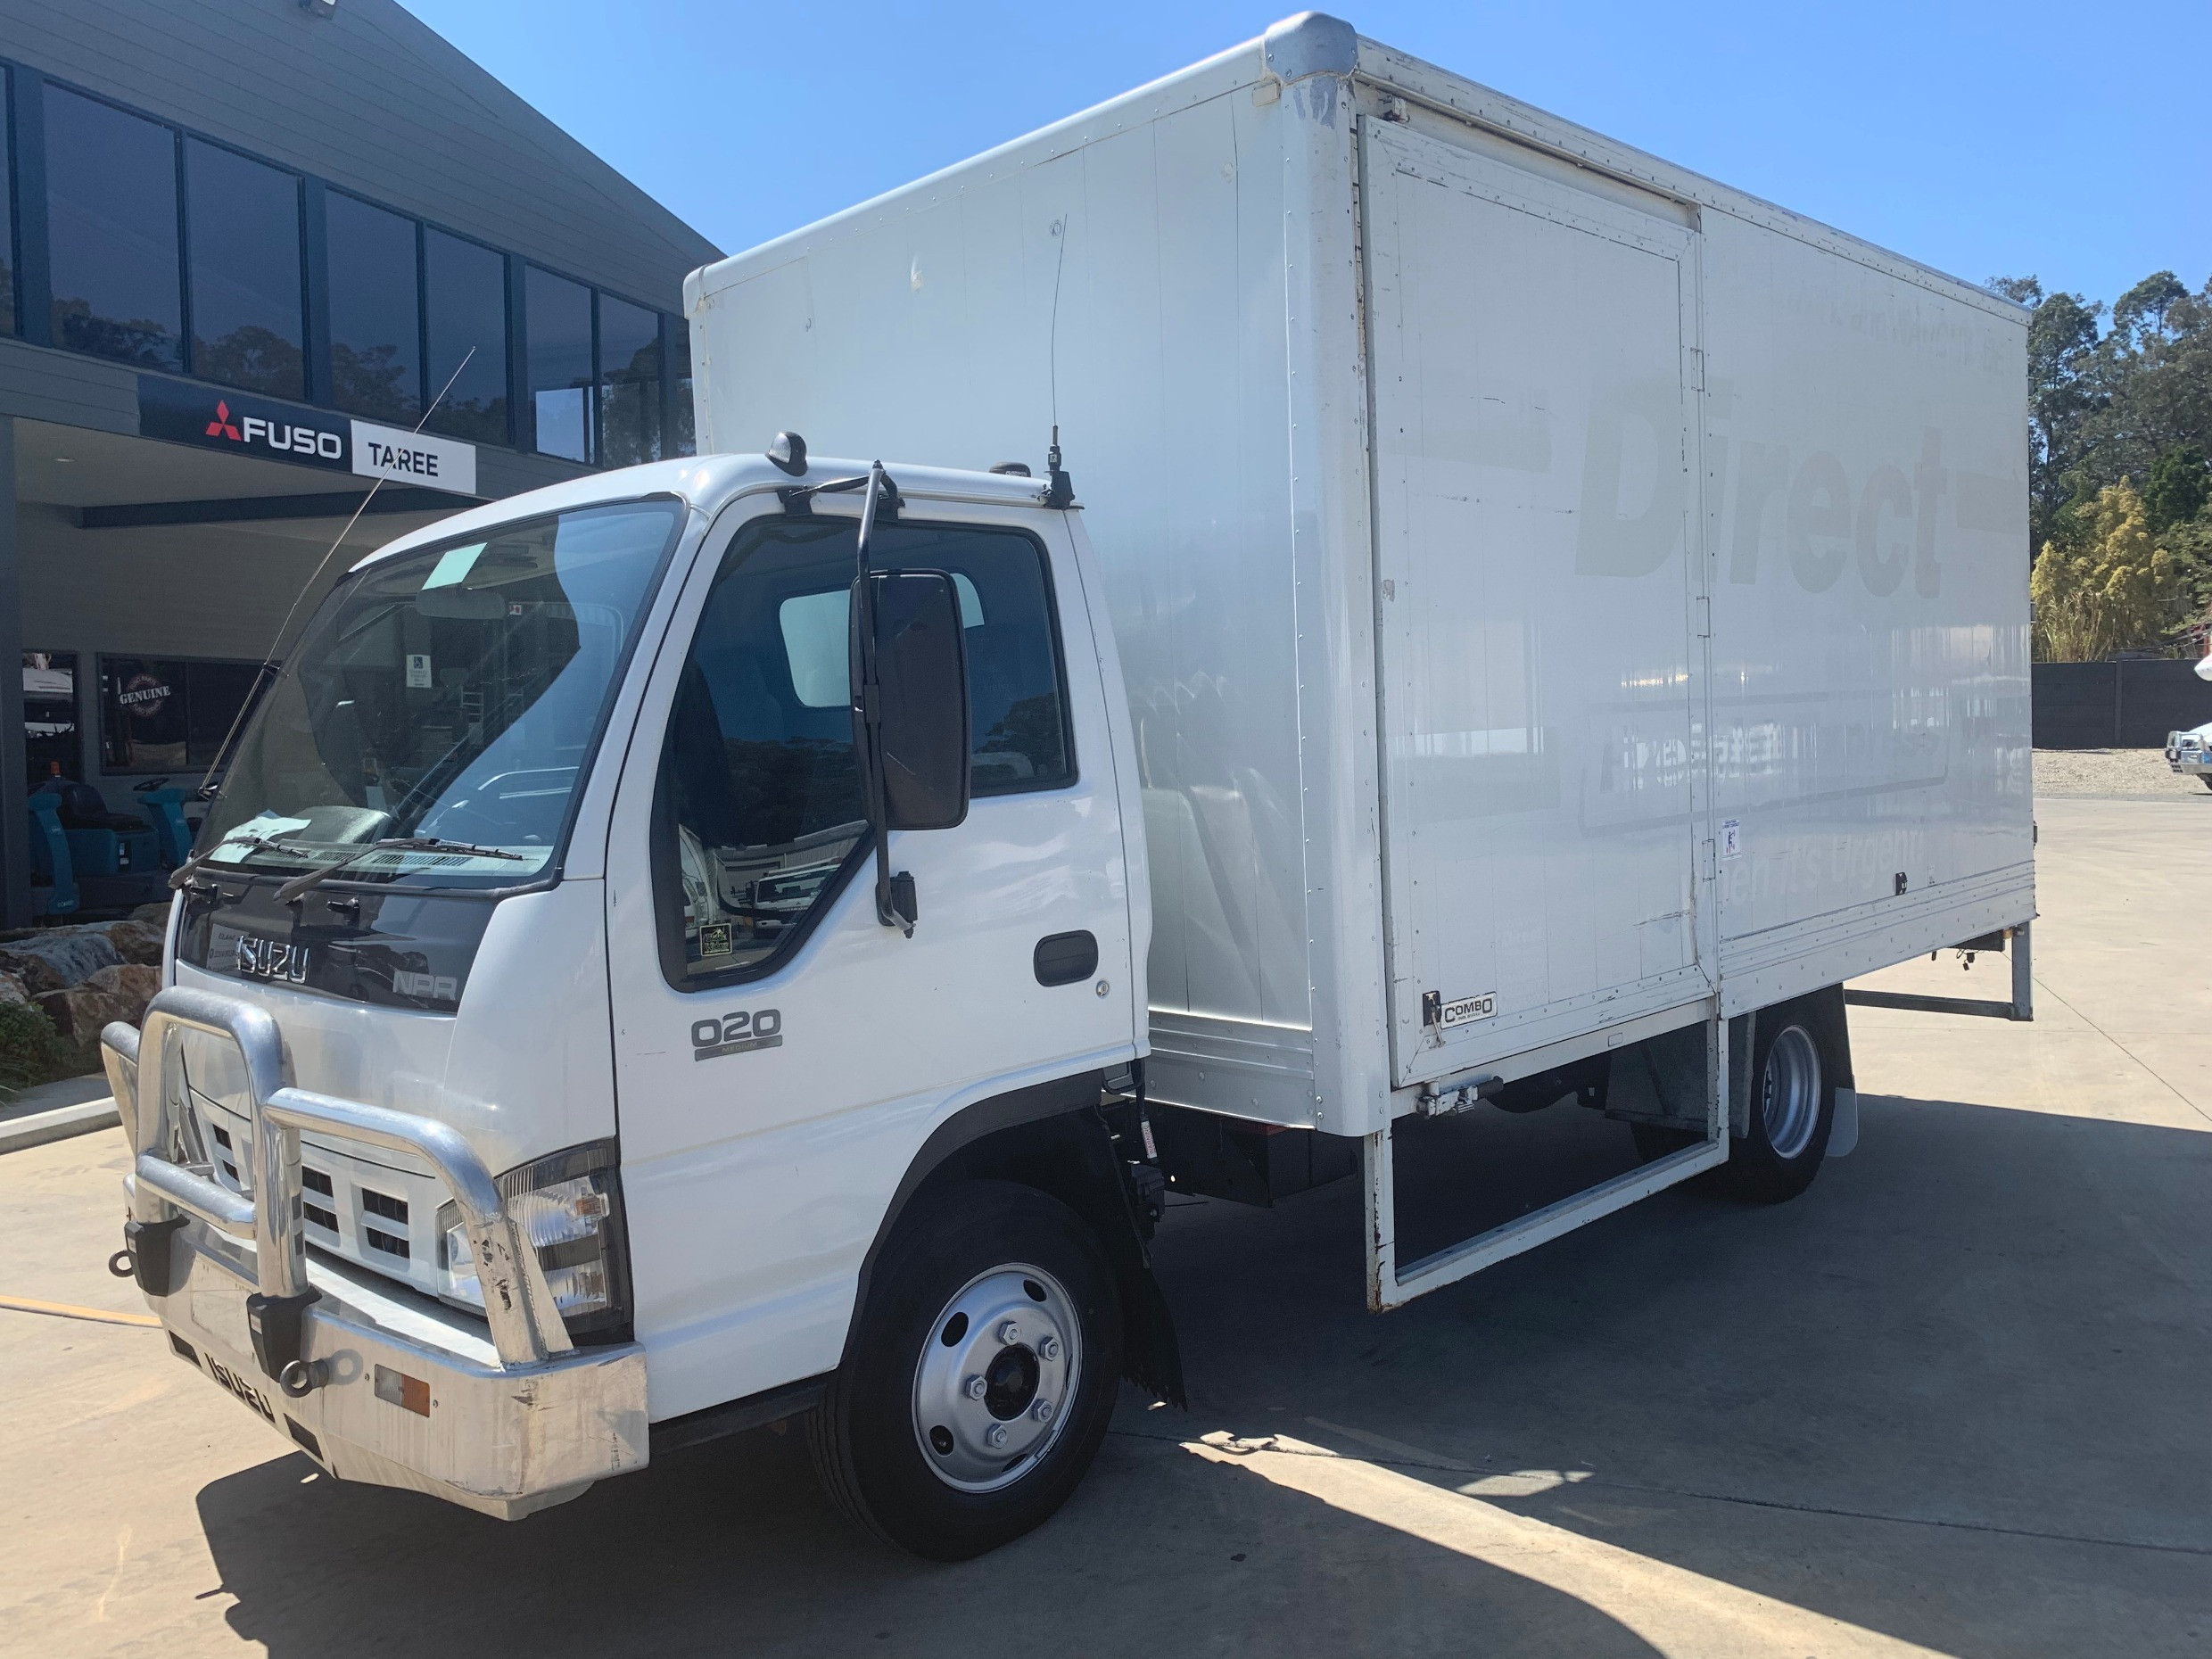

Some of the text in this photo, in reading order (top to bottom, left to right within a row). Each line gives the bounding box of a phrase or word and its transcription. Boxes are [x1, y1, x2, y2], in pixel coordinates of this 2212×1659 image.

[243, 417, 342, 459] FUSO
[367, 442, 438, 477] TAREE
[1574, 375, 1948, 599] Direct
[120, 686, 170, 704] GENUINE
[236, 936, 310, 984] ISUZU
[392, 969, 457, 1001] NPR
[1444, 998, 1493, 1023] COMBO
[722, 1040, 758, 1054] MEDIUM
[204, 1351, 276, 1424] ISUZU
